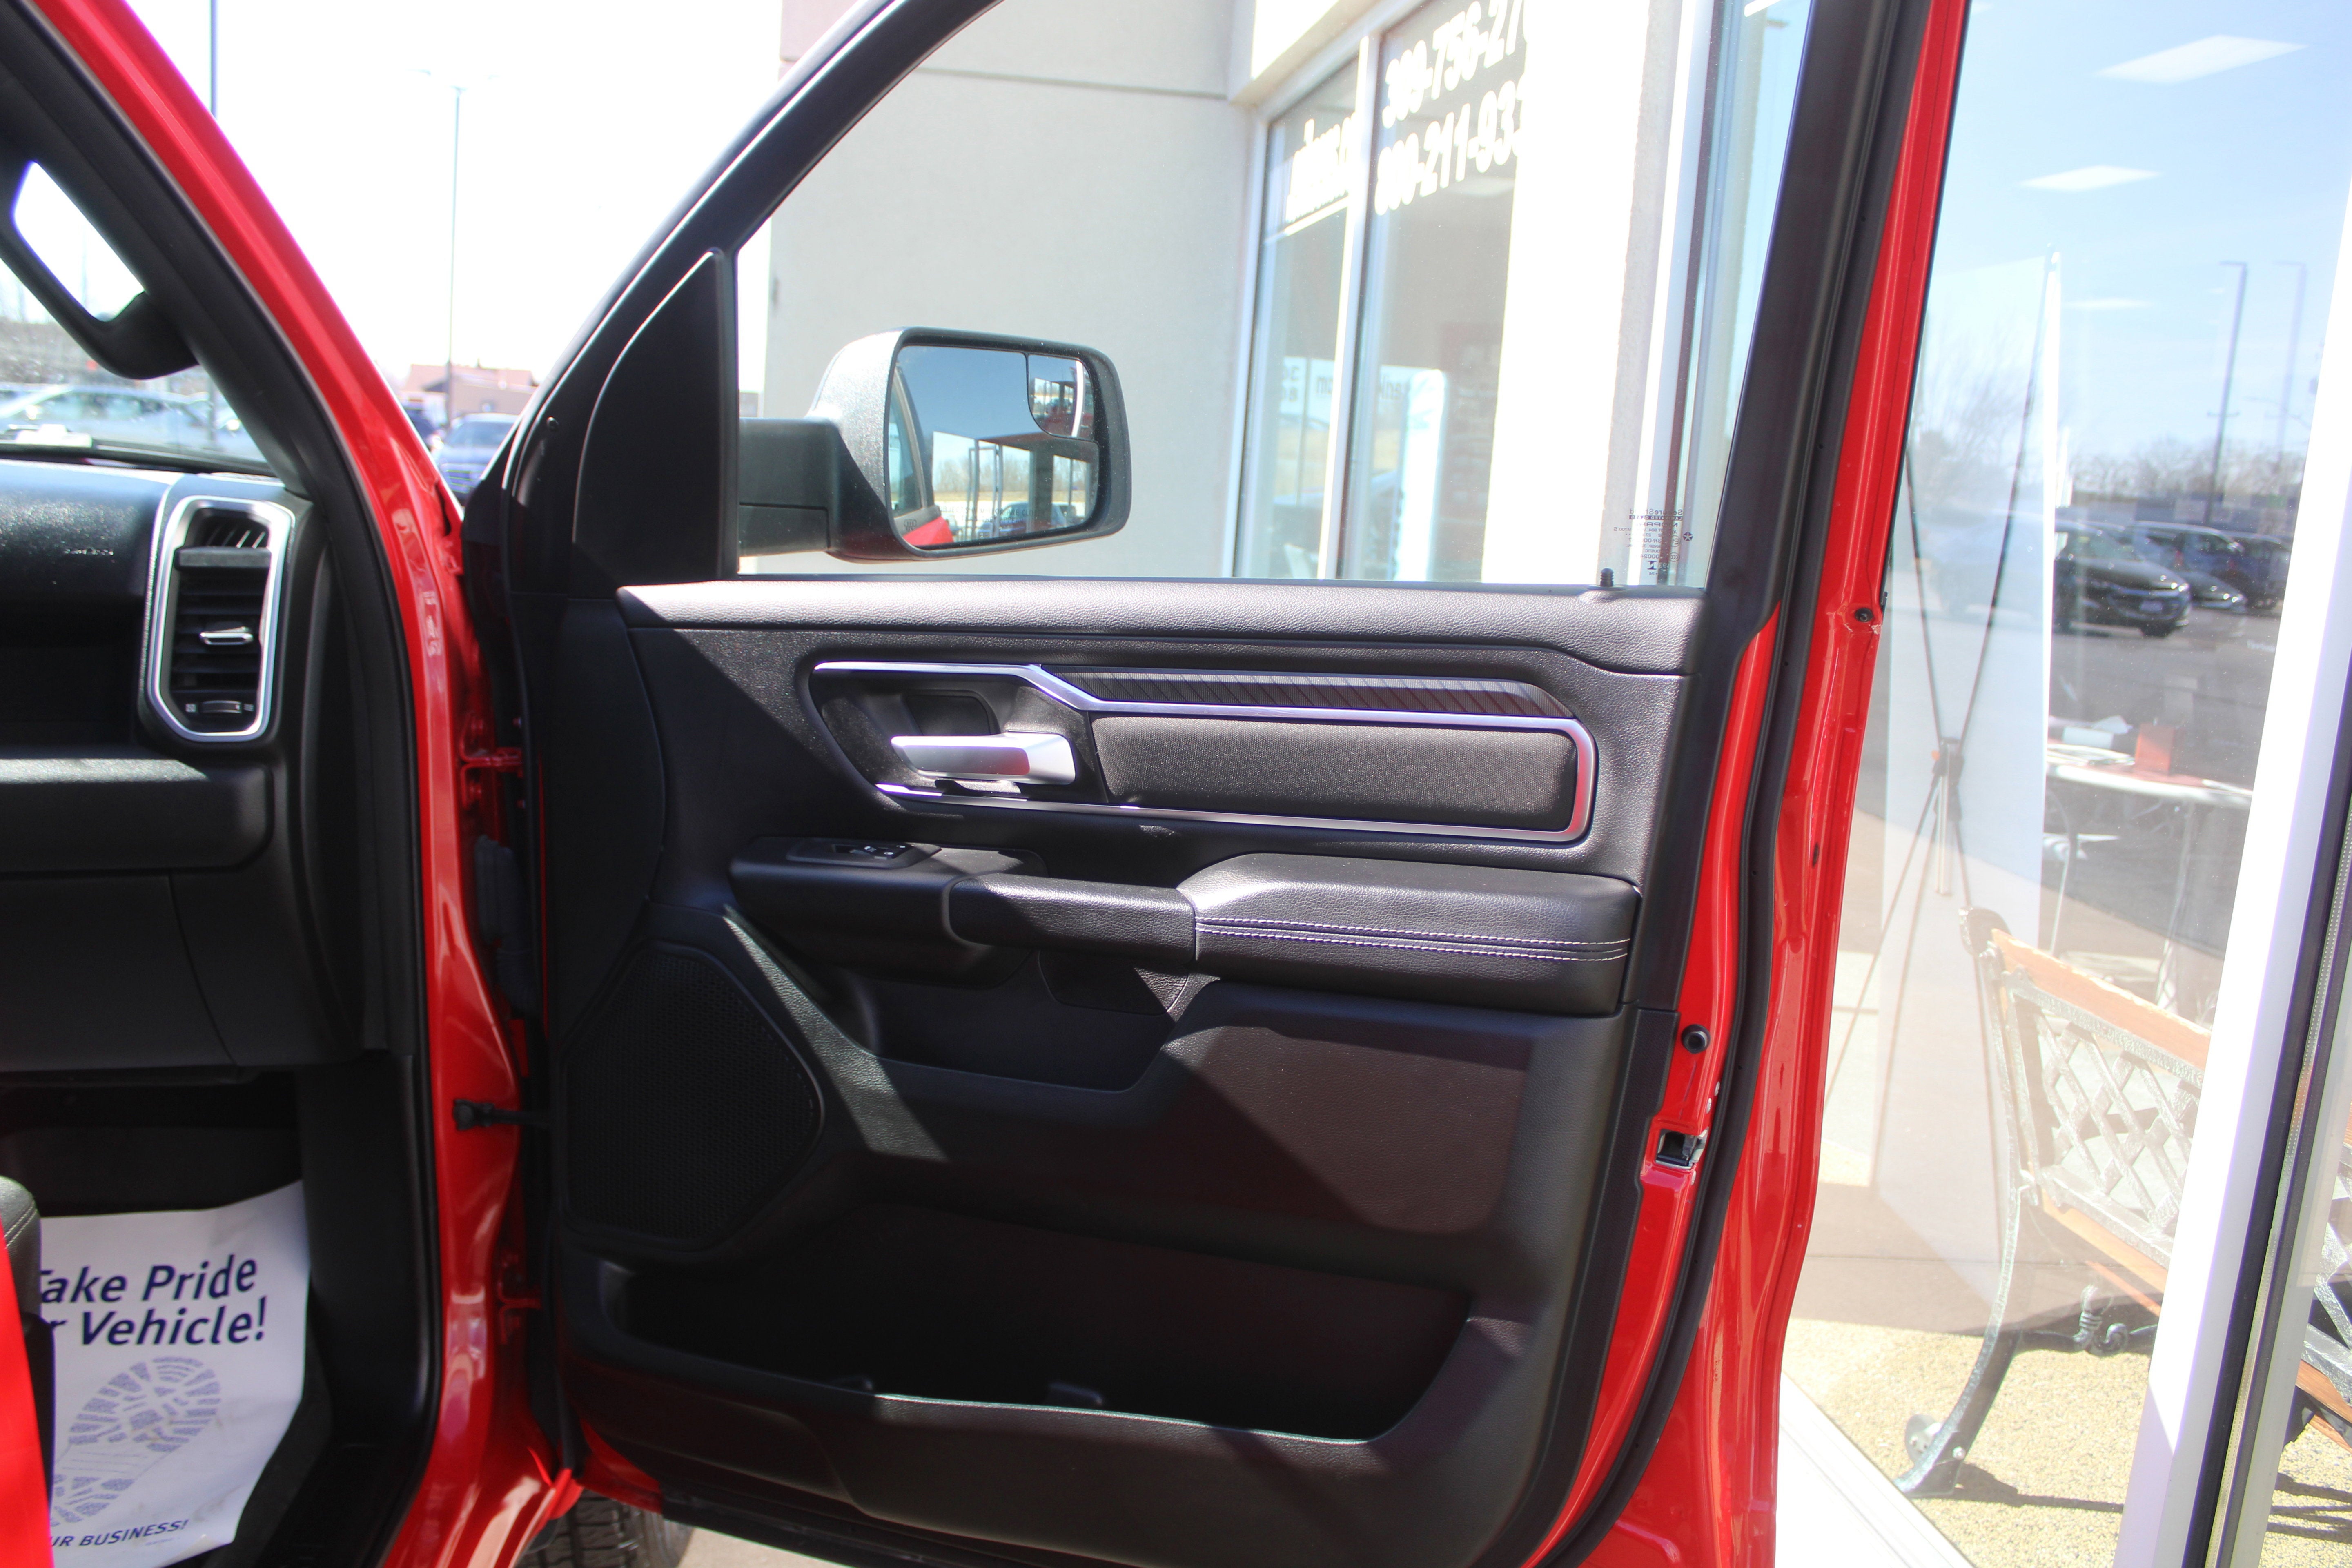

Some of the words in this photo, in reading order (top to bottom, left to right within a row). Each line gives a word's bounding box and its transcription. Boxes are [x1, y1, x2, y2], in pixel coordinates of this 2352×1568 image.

[142, 1254, 258, 1301] Pride
[82, 1296, 267, 1346] Vehicle!
[79, 1519, 189, 1547] BUSINESS!
